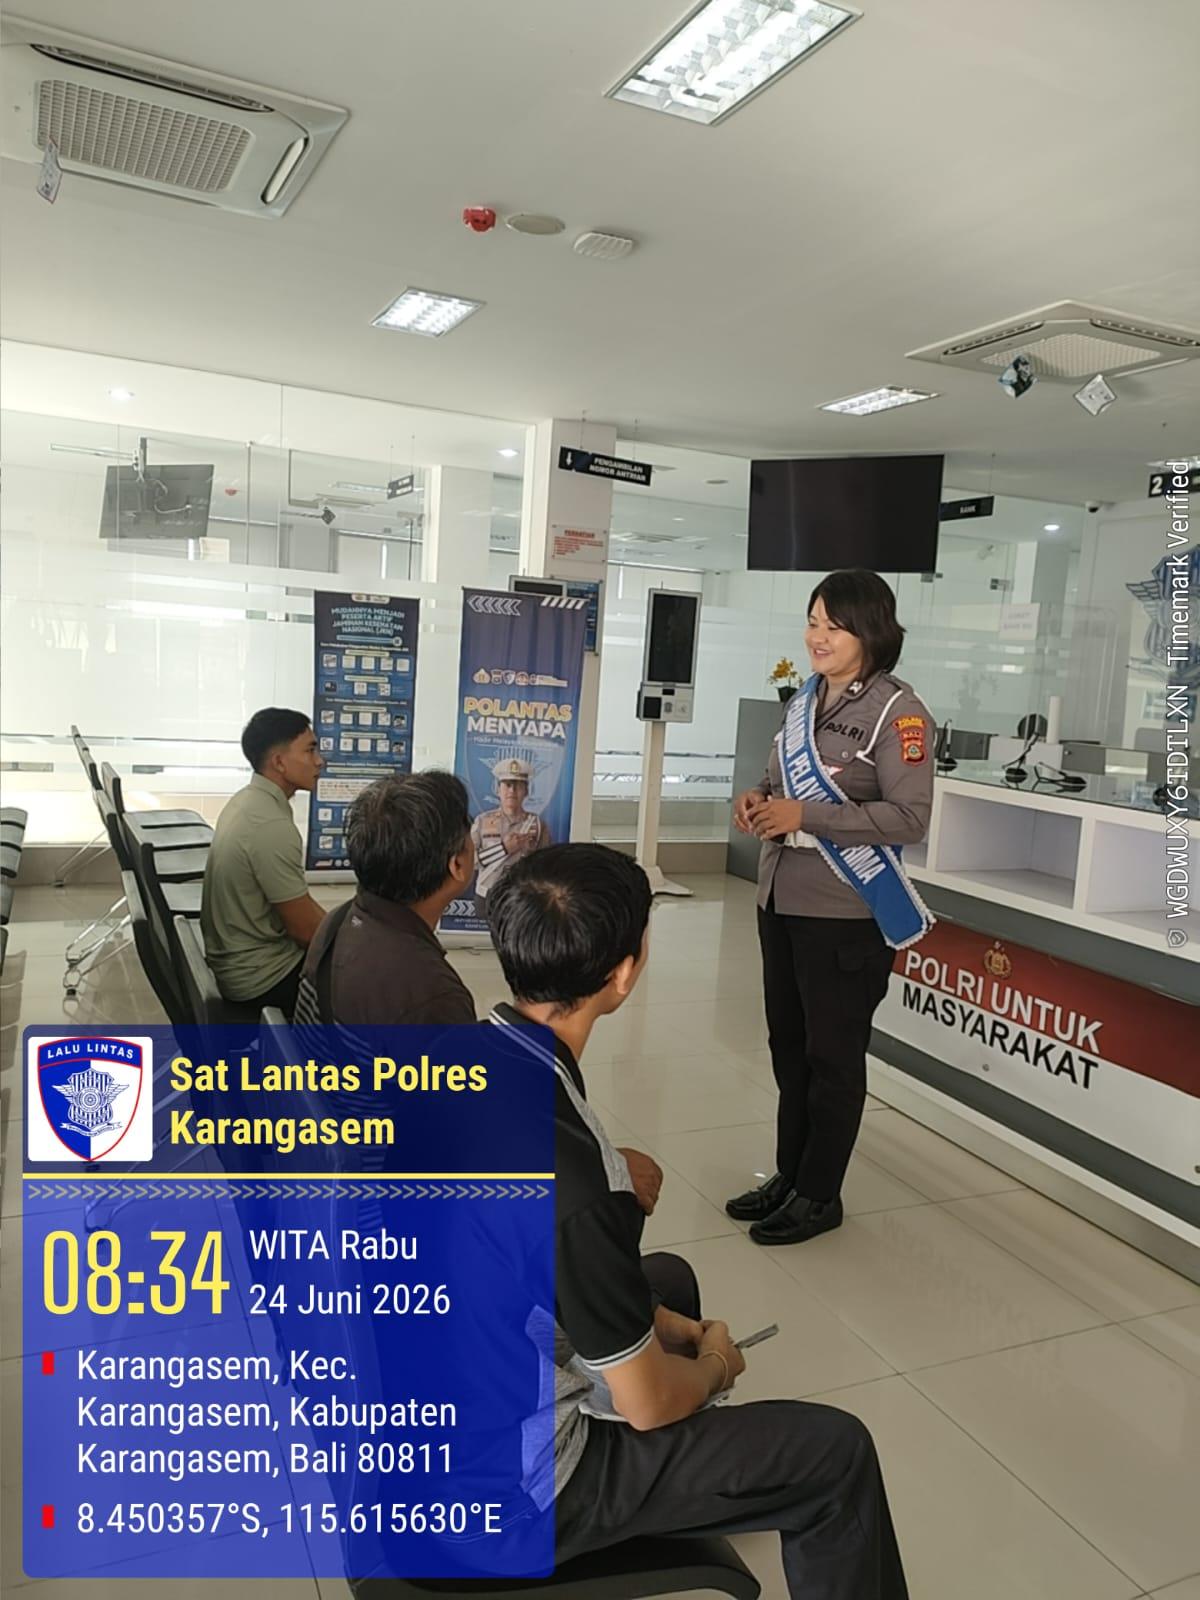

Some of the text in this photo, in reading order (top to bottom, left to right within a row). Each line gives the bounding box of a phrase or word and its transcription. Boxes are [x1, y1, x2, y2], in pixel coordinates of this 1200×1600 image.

[1151, 475, 1163, 495] 2
[464, 696, 573, 722] POLANTAS
[467, 716, 567, 739] MENYAPA
[824, 722, 865, 741] POLRI
[840, 844, 887, 885] RIMA
[904, 949, 1103, 1055] POLRI UNTUK
[902, 982, 1099, 1090] MASYARAKAT
